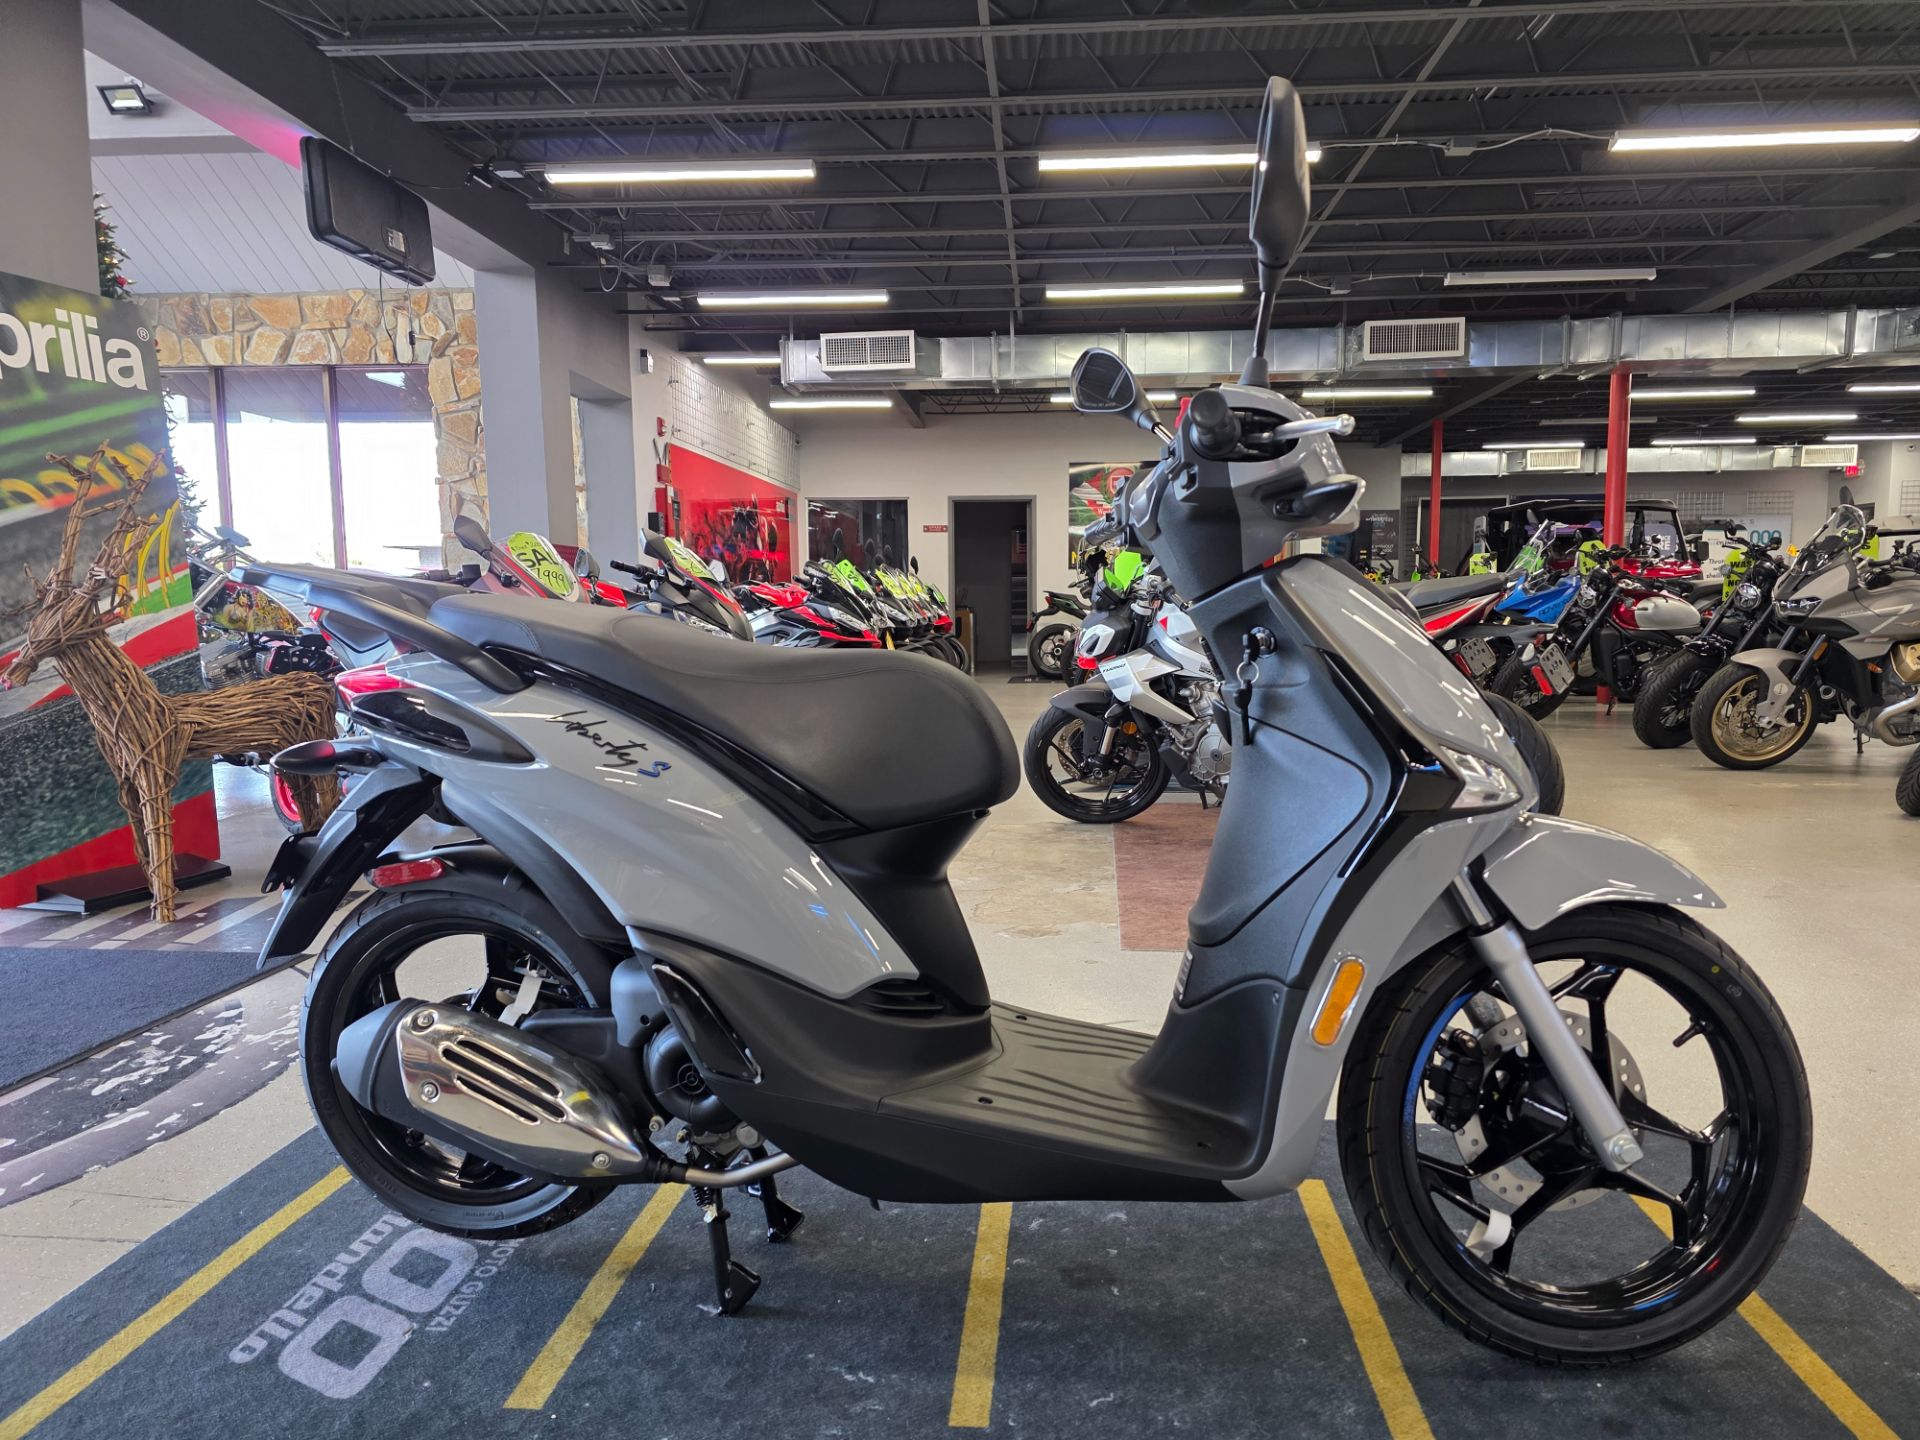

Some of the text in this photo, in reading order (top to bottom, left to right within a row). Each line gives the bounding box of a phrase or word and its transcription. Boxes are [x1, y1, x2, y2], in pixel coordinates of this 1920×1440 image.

[545, 710, 672, 778] Liberty S
[424, 1281, 485, 1332] GUZZI
